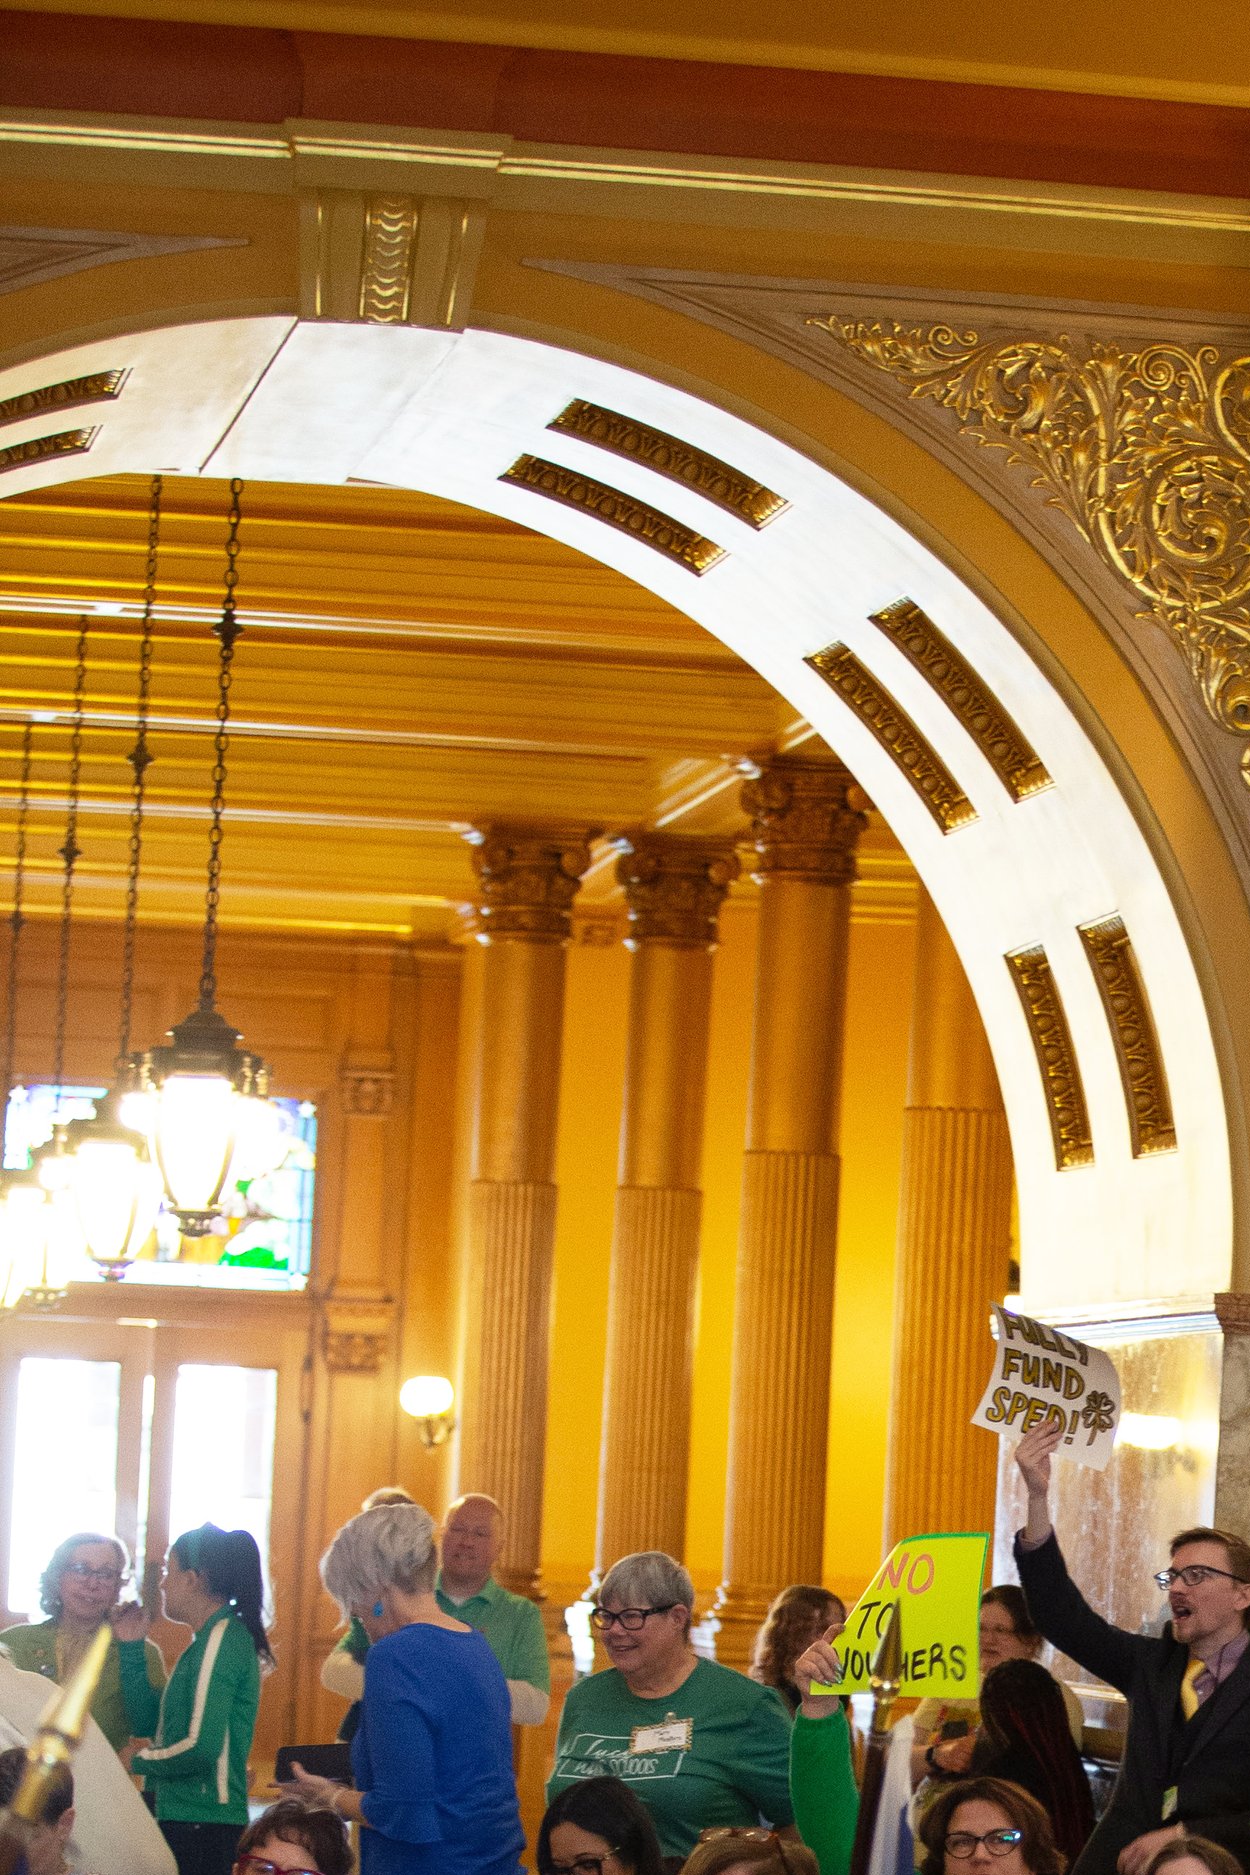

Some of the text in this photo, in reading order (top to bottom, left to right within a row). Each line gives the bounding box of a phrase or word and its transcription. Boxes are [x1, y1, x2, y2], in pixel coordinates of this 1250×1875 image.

[1001, 1347, 1086, 1400] FUND
[985, 1386, 1080, 1445] SPED!
[877, 1552, 935, 1595] NO
